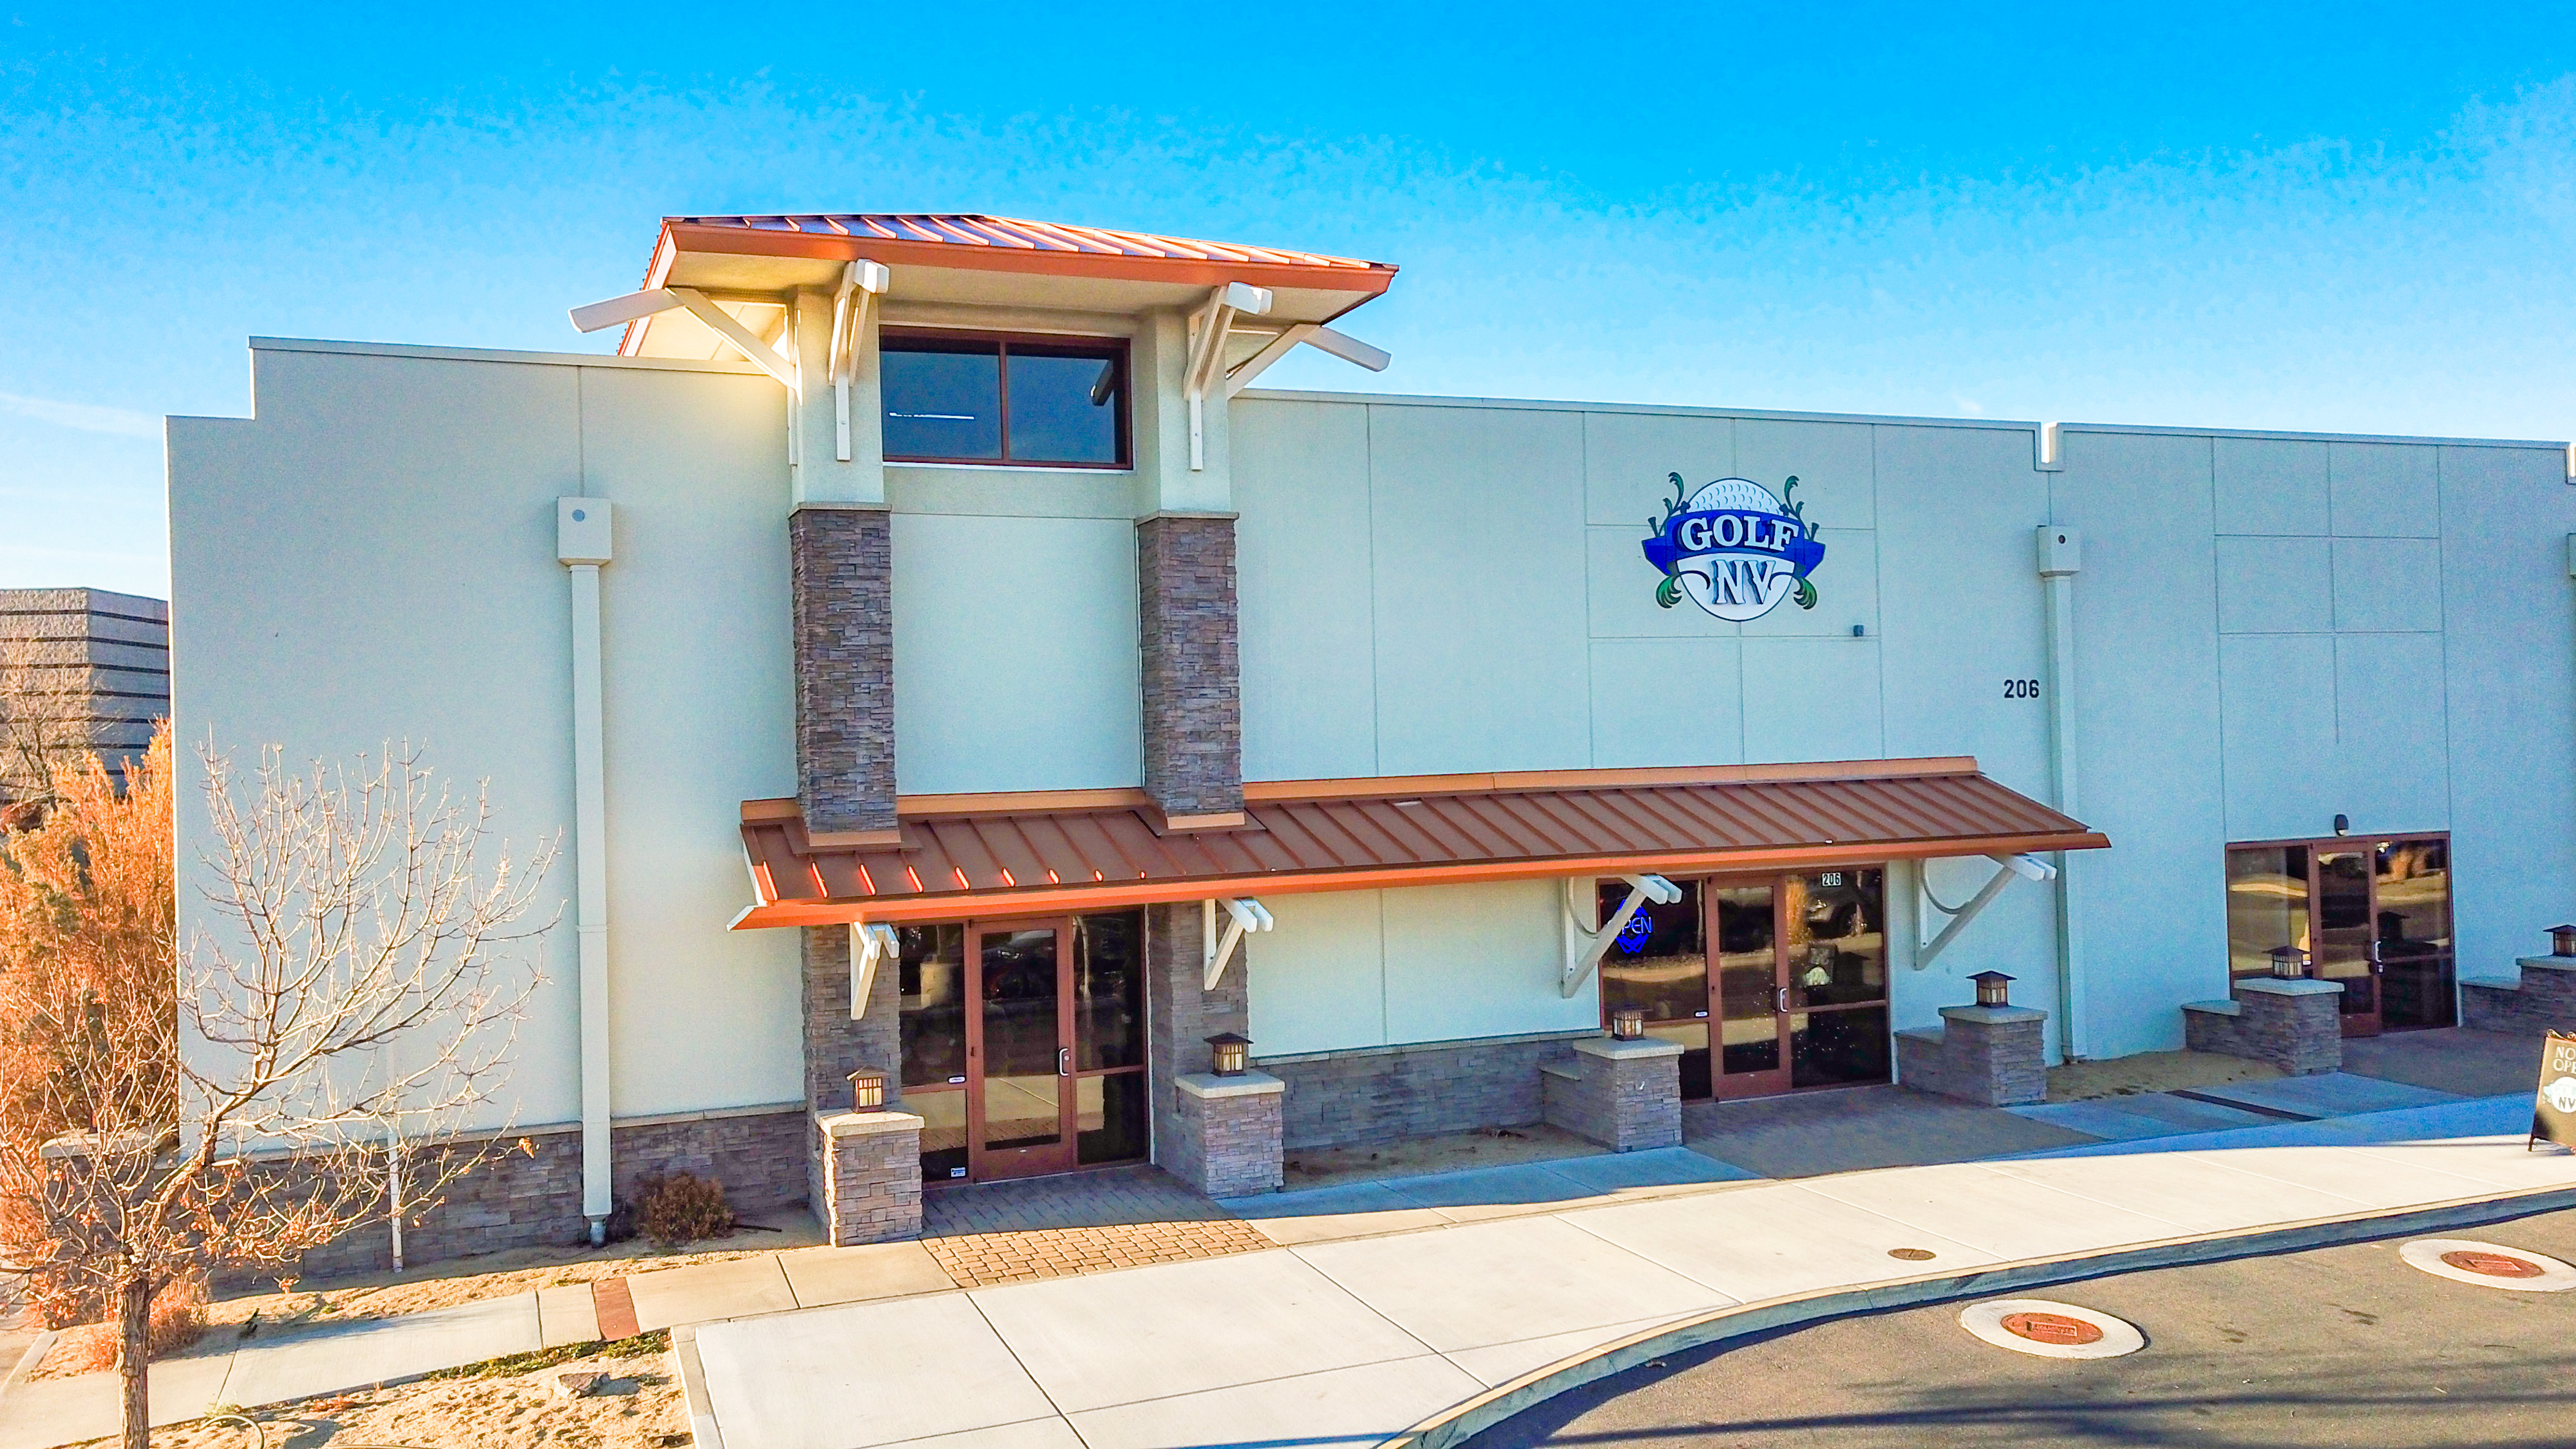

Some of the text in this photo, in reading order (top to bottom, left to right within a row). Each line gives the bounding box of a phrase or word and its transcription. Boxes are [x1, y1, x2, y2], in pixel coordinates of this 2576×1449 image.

[1681, 514, 1800, 552] GOLF
[1712, 559, 1776, 605] NV
[2004, 679, 2039, 698] 206
[1823, 873, 1840, 885] 206
[1608, 916, 1652, 934] PEN
[2559, 1096, 2576, 1109] NV
